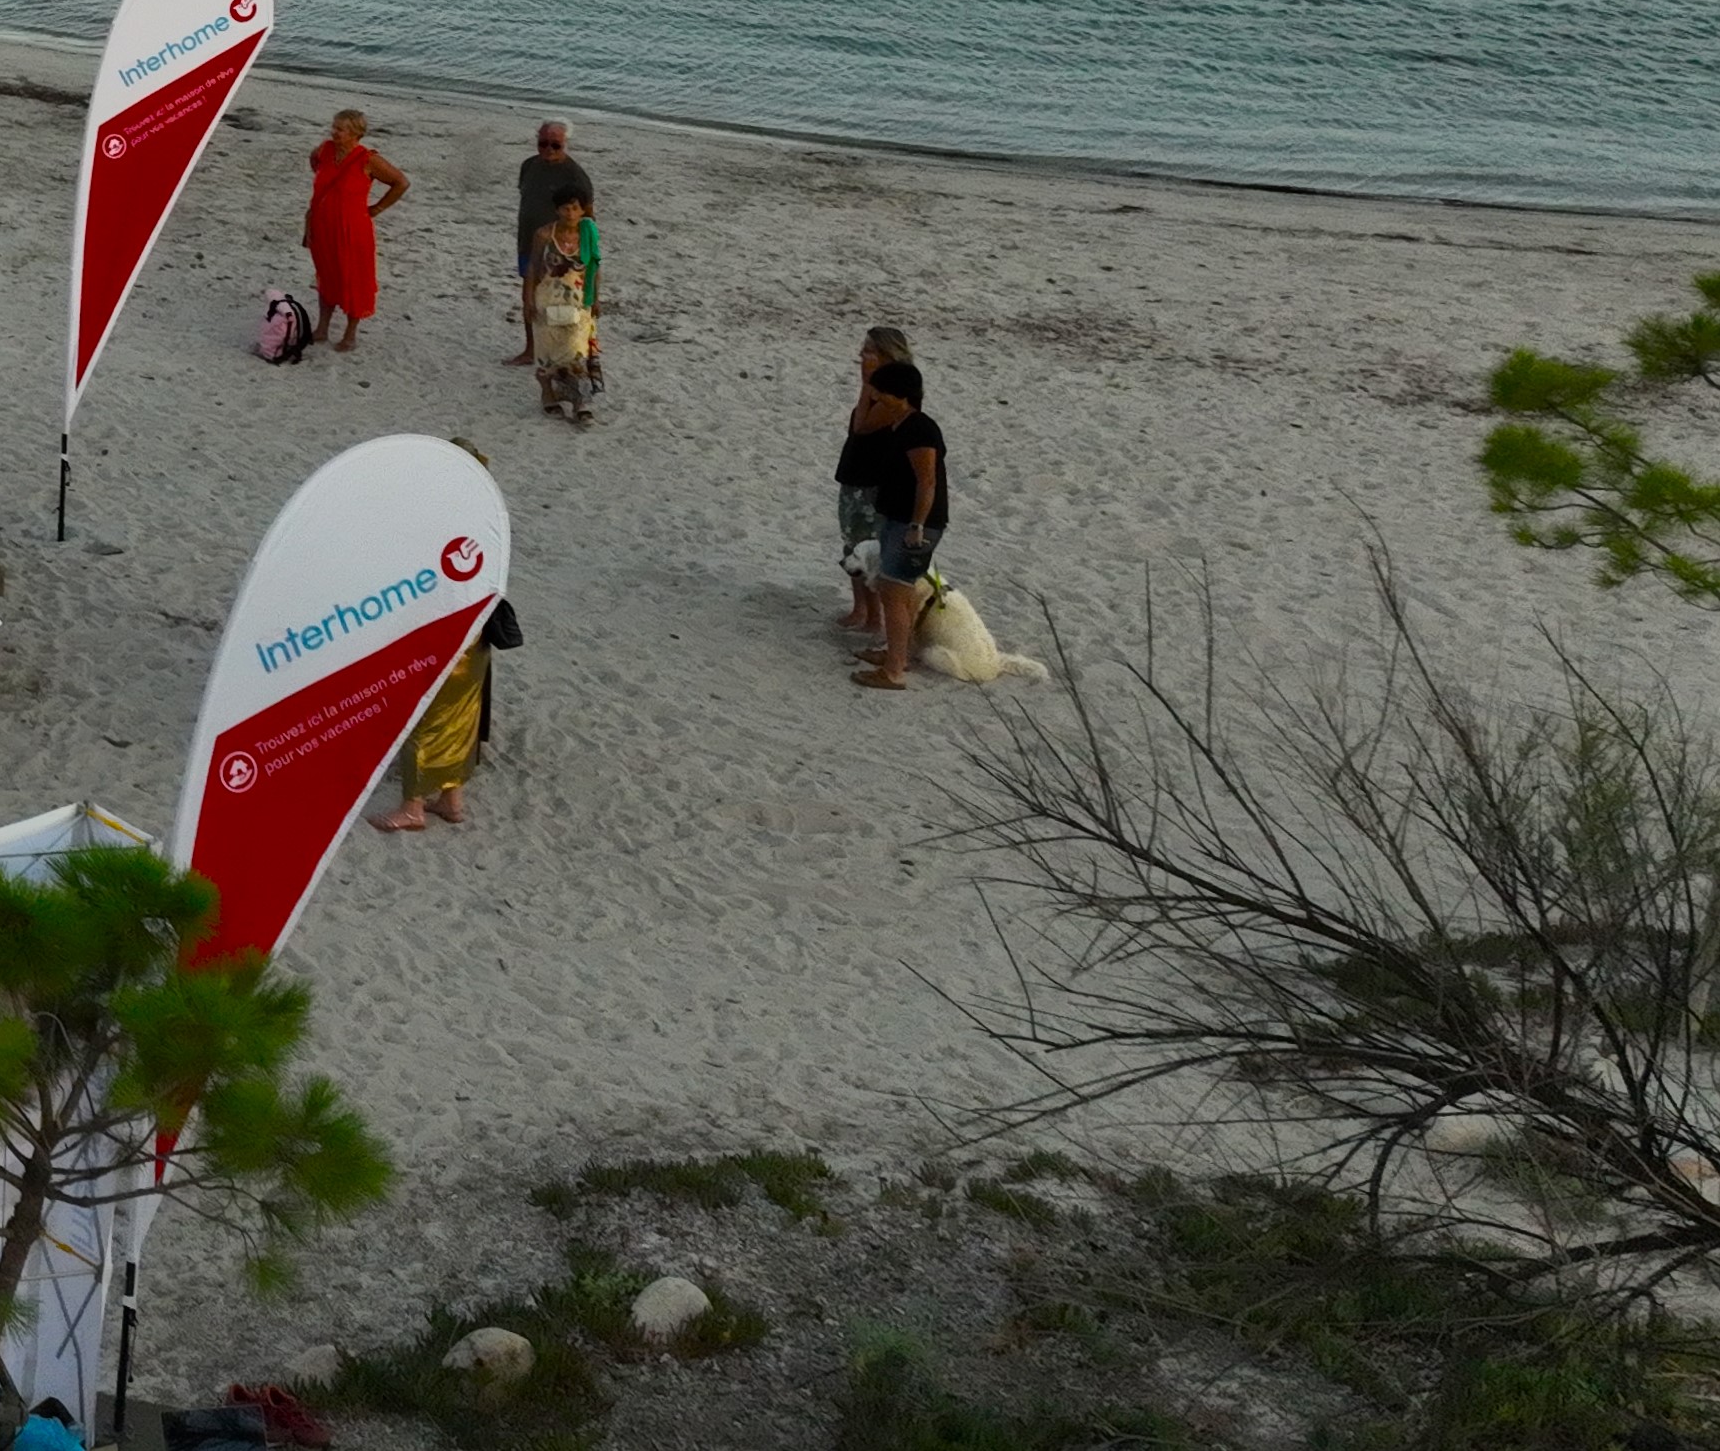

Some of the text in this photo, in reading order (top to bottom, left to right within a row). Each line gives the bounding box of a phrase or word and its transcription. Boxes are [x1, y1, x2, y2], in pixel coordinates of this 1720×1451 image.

[118, 15, 231, 88] Interhome
[255, 568, 438, 674] Interhome
[254, 722, 307, 755] Trouvez
[323, 706, 338, 719] la
[339, 678, 388, 711] maison
[388, 669, 407, 684] de
[264, 750, 294, 777] pour
[295, 737, 319, 756] vos
[320, 703, 382, 743] vacances
